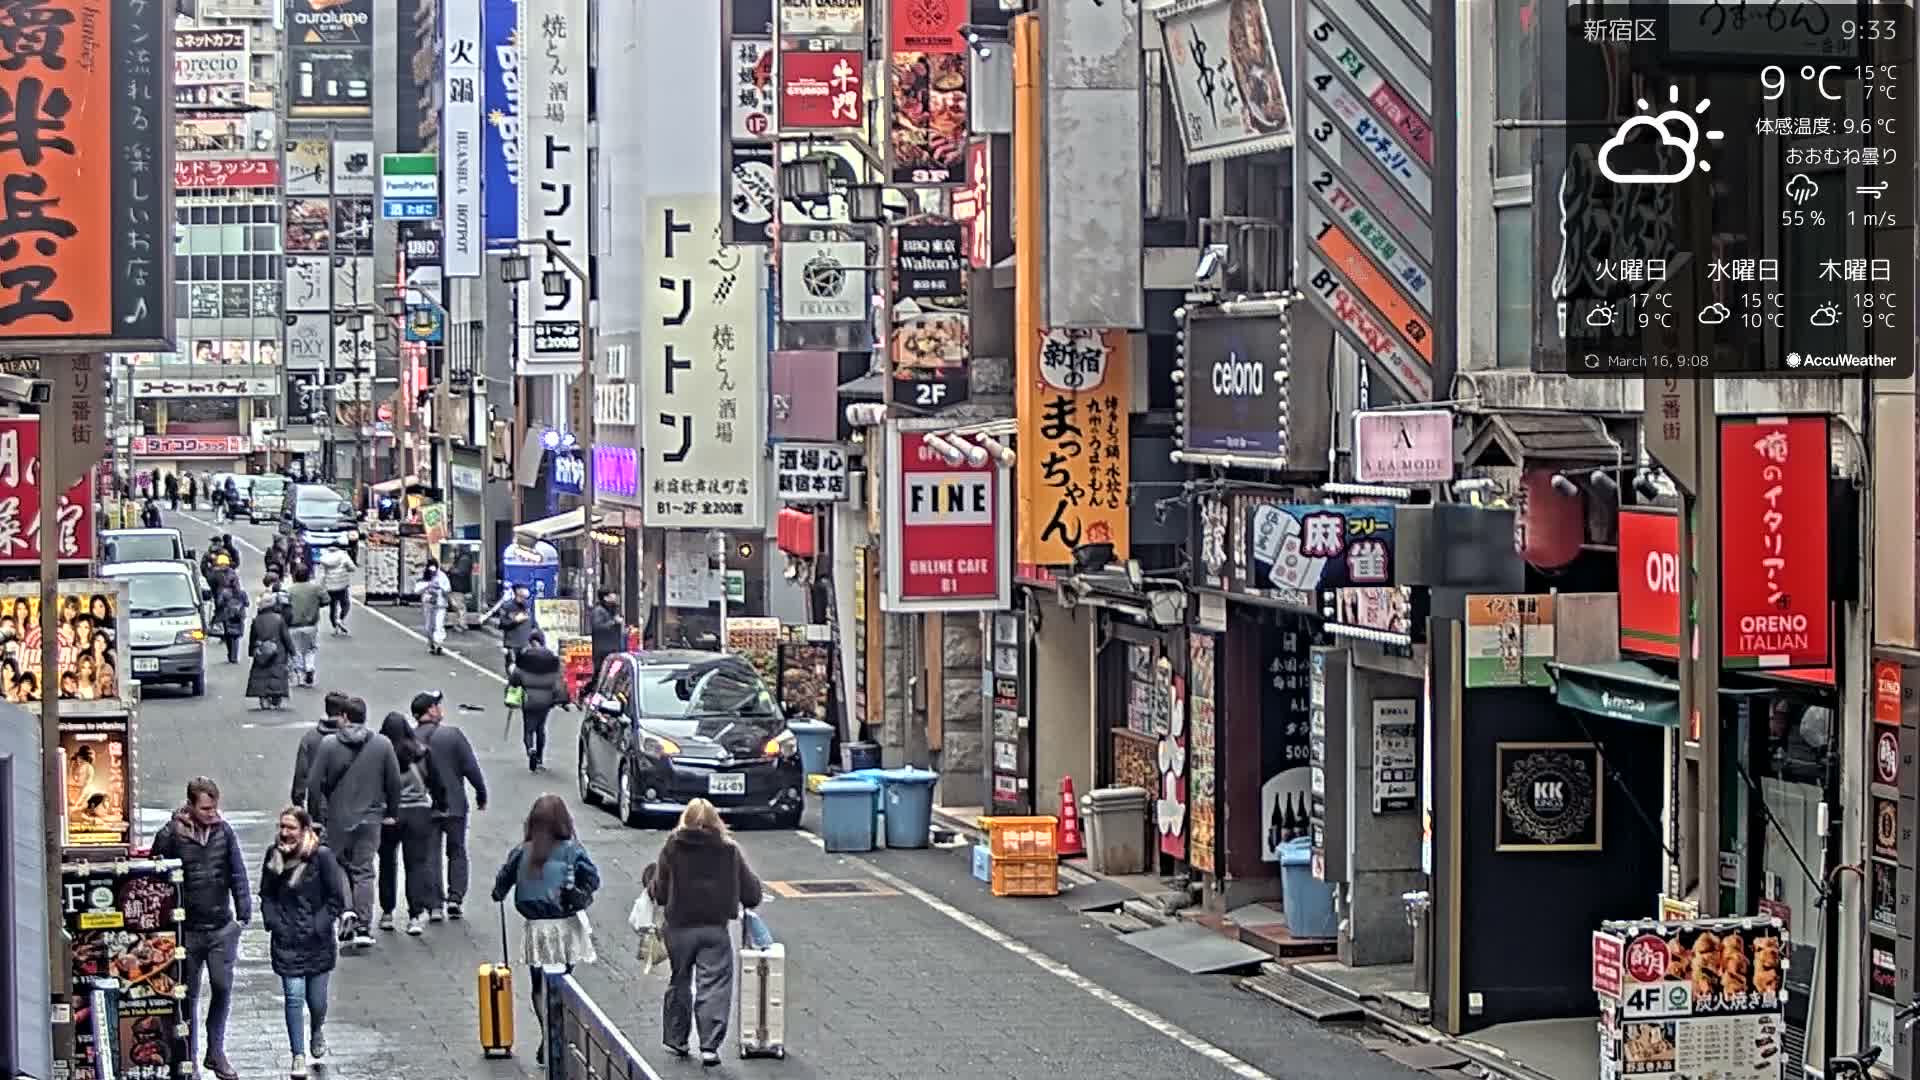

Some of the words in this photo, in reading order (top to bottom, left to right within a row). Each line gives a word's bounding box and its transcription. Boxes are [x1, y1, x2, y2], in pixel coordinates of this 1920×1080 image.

[1313, 22, 1334, 42] 5
[808, 38, 836, 52] 2F
[450, 39, 474, 103] 火鍋
[829, 57, 860, 121] 牛門
[1313, 74, 1333, 91] 4
[749, 116, 767, 133] 1F
[1314, 121, 1334, 142] 3
[1312, 171, 1333, 193] 2
[900, 254, 960, 271] Walton's
[1311, 267, 1340, 298] B1
[659, 208, 692, 462] トントン
[1043, 340, 1104, 374] 新宿
[1063, 371, 1084, 388] の
[1212, 351, 1264, 395] celona
[916, 384, 946, 405] 2F
[779, 450, 843, 471] 酒場心
[1040, 394, 1085, 548] まっちゃん
[1401, 458, 1442, 471] MODE
[910, 484, 986, 513] FINE
[1348, 518, 1390, 535] フリー
[1753, 430, 1788, 605] 俺のイタリアン
[909, 559, 953, 575] ONLINE
[957, 558, 989, 574] CAFE
[1739, 614, 1808, 633] ORENO
[1739, 633, 1808, 650] ITALIAN
[1533, 781, 1564, 799] KK
[1626, 988, 1661, 1012] 4F
[1695, 990, 1778, 1012] 炭火焼き鳥
